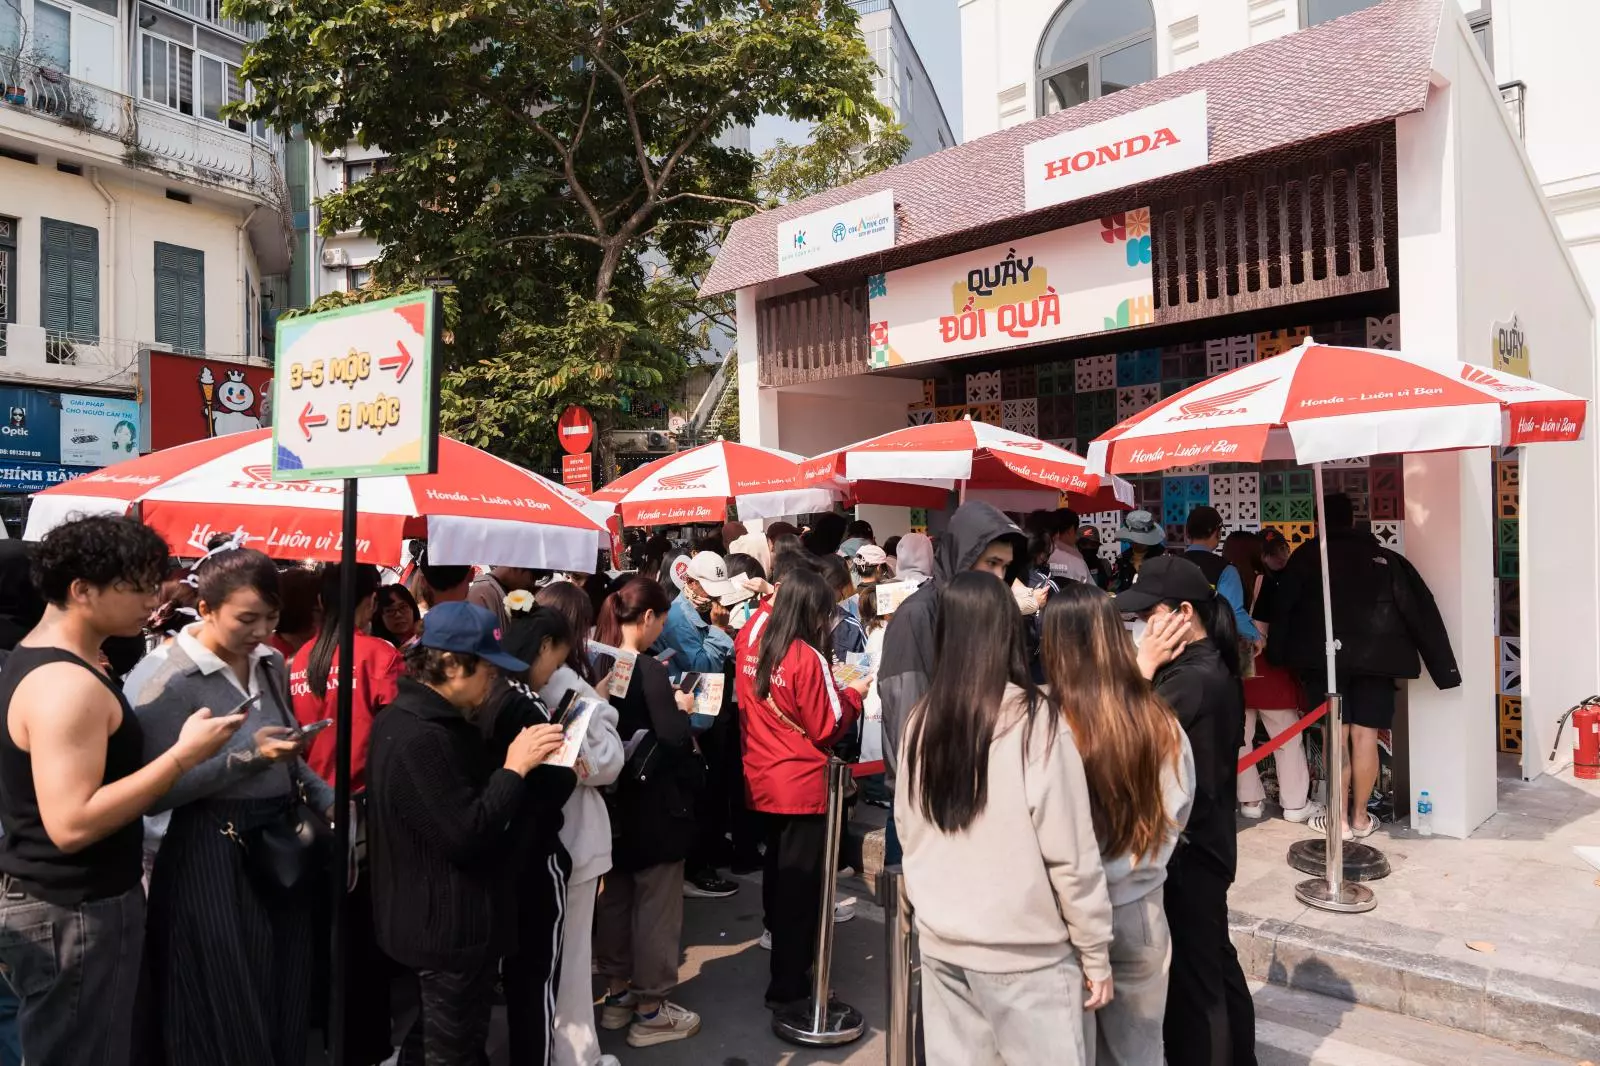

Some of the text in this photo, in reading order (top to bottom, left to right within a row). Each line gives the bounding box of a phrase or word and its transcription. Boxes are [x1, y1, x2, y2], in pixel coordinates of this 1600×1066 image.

[1045, 127, 1181, 181] HONDA
[967, 248, 1034, 297] QUẦY
[939, 285, 1061, 343] ĐỔI QUÀ
[290, 347, 371, 390] 3-5 MỘC
[1300, 396, 1344, 408] Honda
[1360, 391, 1394, 401] Luôn
[1397, 387, 1410, 397] vì
[1414, 386, 1443, 396] Bạn
[336, 392, 401, 436] 6 MỘC
[2, 425, 28, 437] Optic
[1130, 447, 1163, 463] Honda
[1174, 444, 1201, 457] Luôn
[1213, 440, 1238, 456] Bạn
[1005, 460, 1030, 476] Honda
[1039, 468, 1060, 483] Luôn
[651, 483, 707, 492] HONDA
[426, 488, 470, 502] Honda
[481, 494, 511, 506] Luôn
[513, 496, 525, 507] vì
[525, 498, 552, 511] Bạn
[637, 508, 660, 520] Honda
[668, 507, 685, 518] Luôn
[696, 505, 711, 518] Bạn
[267, 526, 312, 549] Luôn
[315, 529, 334, 551] vì
